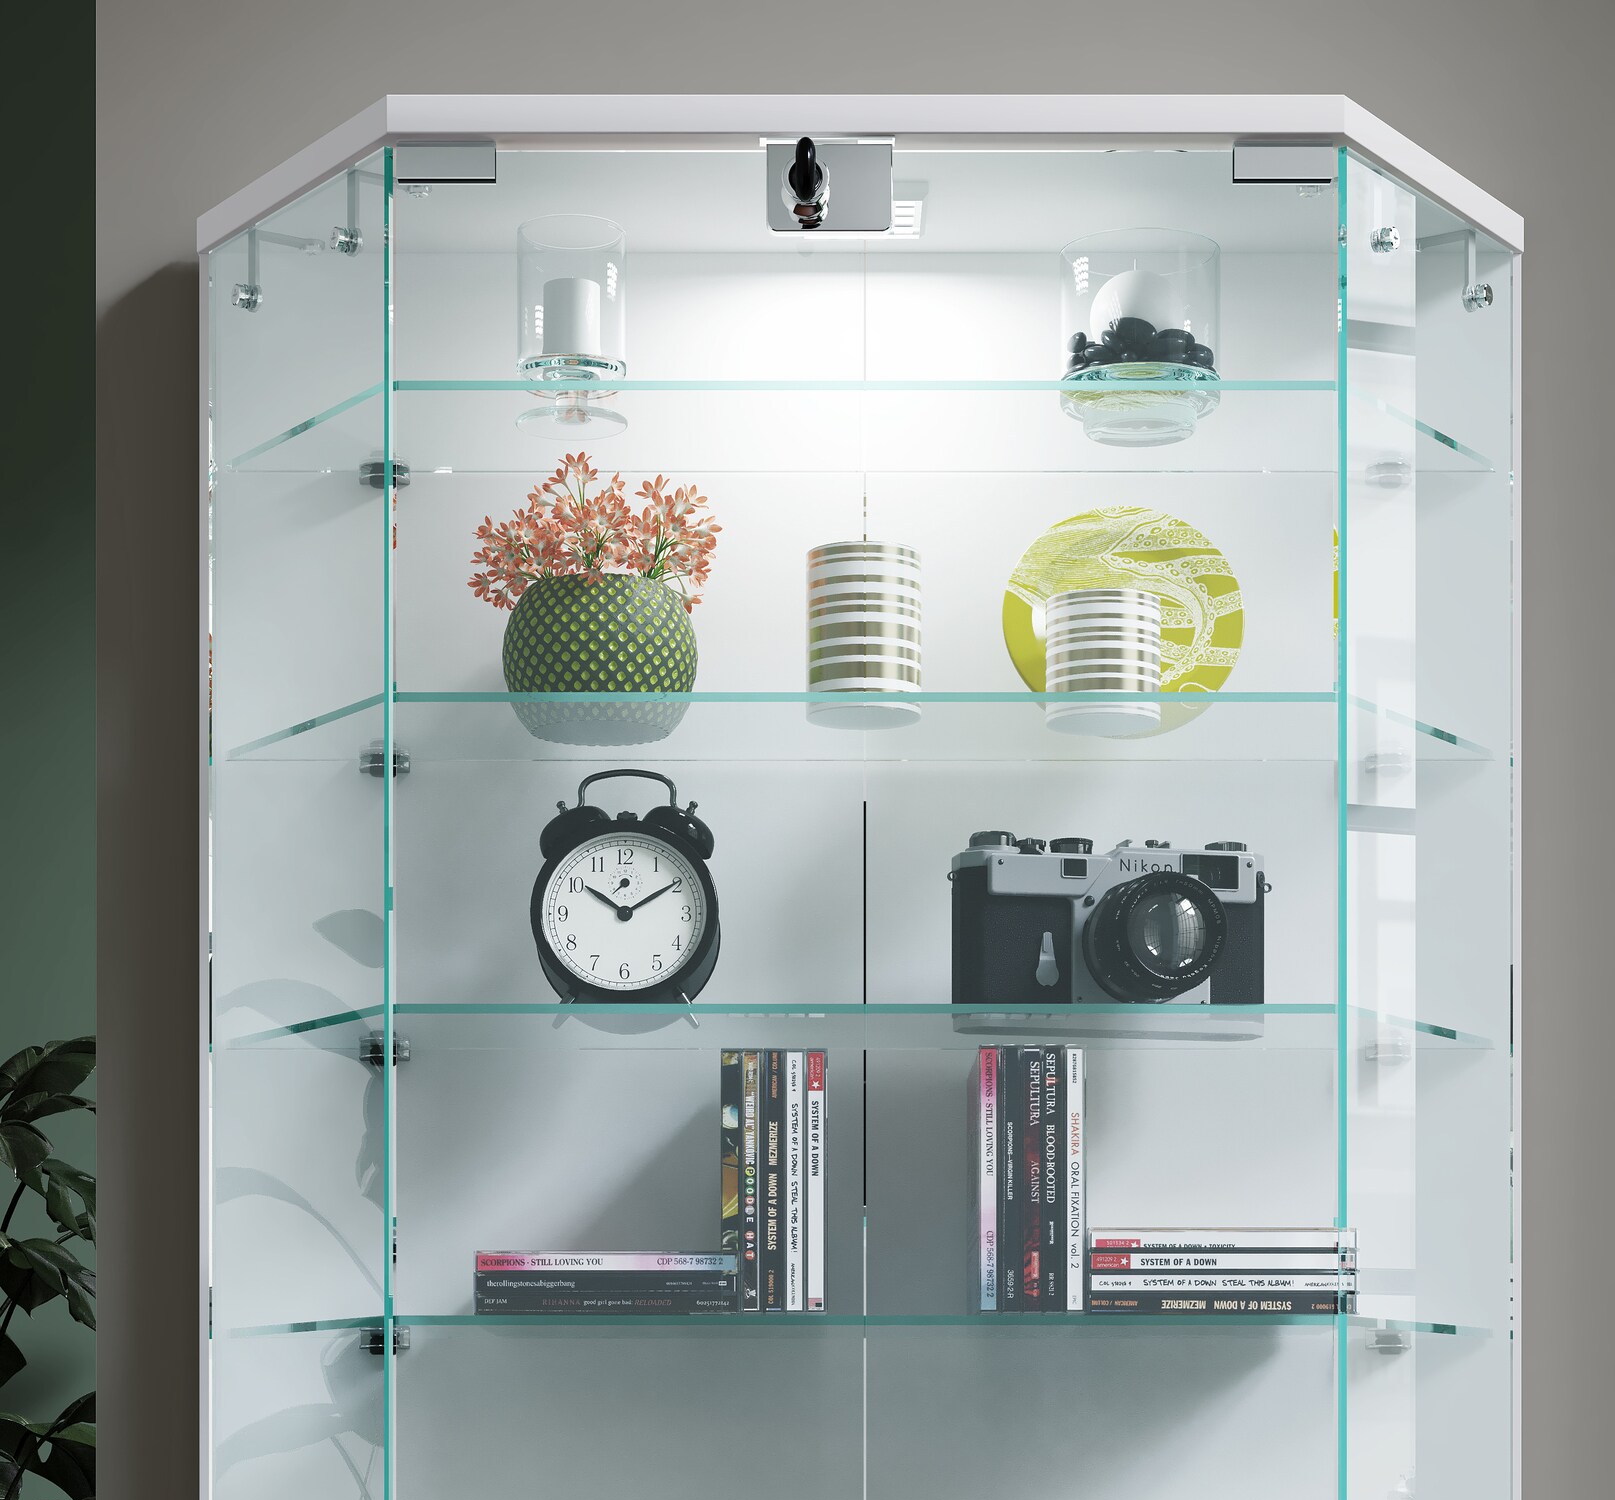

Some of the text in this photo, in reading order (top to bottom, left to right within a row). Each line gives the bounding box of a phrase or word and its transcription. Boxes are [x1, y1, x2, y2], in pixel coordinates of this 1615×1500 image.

[591, 857, 604, 872] 11
[617, 849, 634, 865] 12
[653, 857, 659, 872] 1
[1120, 859, 1173, 873] Nikon
[569, 877, 584, 893] 10
[672, 877, 682, 893] 2
[558, 906, 568, 922] 9
[681, 906, 692, 922] 3
[566, 935, 577, 950] 8
[672, 935, 682, 950] 4
[590, 955, 600, 971] 7
[619, 963, 630, 979] 6
[652, 955, 662, 971] 5
[985, 1053, 993, 1098] SCORPIONS
[1046, 1053, 1056, 1115] SEPULTURA
[985, 1103, 993, 1126] STILL
[812, 1134, 819, 1143] OF
[1029, 1061, 1040, 1203] SEPULTURA AGAINST
[1071, 1112, 1079, 1155] SHAKIRA
[745, 1130, 755, 1165] YANKOVIC
[769, 1121, 778, 1165] MEZMERIZE
[792, 1137, 798, 1145] OF
[1046, 1124, 1056, 1203] BLOOD-ROOTED
[1071, 1161, 1079, 1188] ORAL
[768, 1173, 777, 1197] DOWN
[745, 1168, 755, 1223] POODLE
[768, 1207, 777, 1217] OF
[1071, 1192, 1079, 1237] FIXATION
[768, 1220, 777, 1250] SYSTEM
[745, 1231, 755, 1259] HAT
[1071, 1243, 1079, 1259] vol.
[530, 1258, 553, 1266] STILL
[554, 1258, 584, 1266] LOVING
[586, 1258, 603, 1266] YOU
[1141, 1258, 1217, 1266] SYSTEM OF A DOWN
[487, 1280, 575, 1288] therollingstonesabiggerbang
[1161, 1300, 1206, 1309] MEZMERIZE
[1214, 1300, 1238, 1310] DOWN
[1240, 1301, 1246, 1310] A
[1248, 1301, 1258, 1310] OF
[1260, 1301, 1292, 1310] SYSTEM
